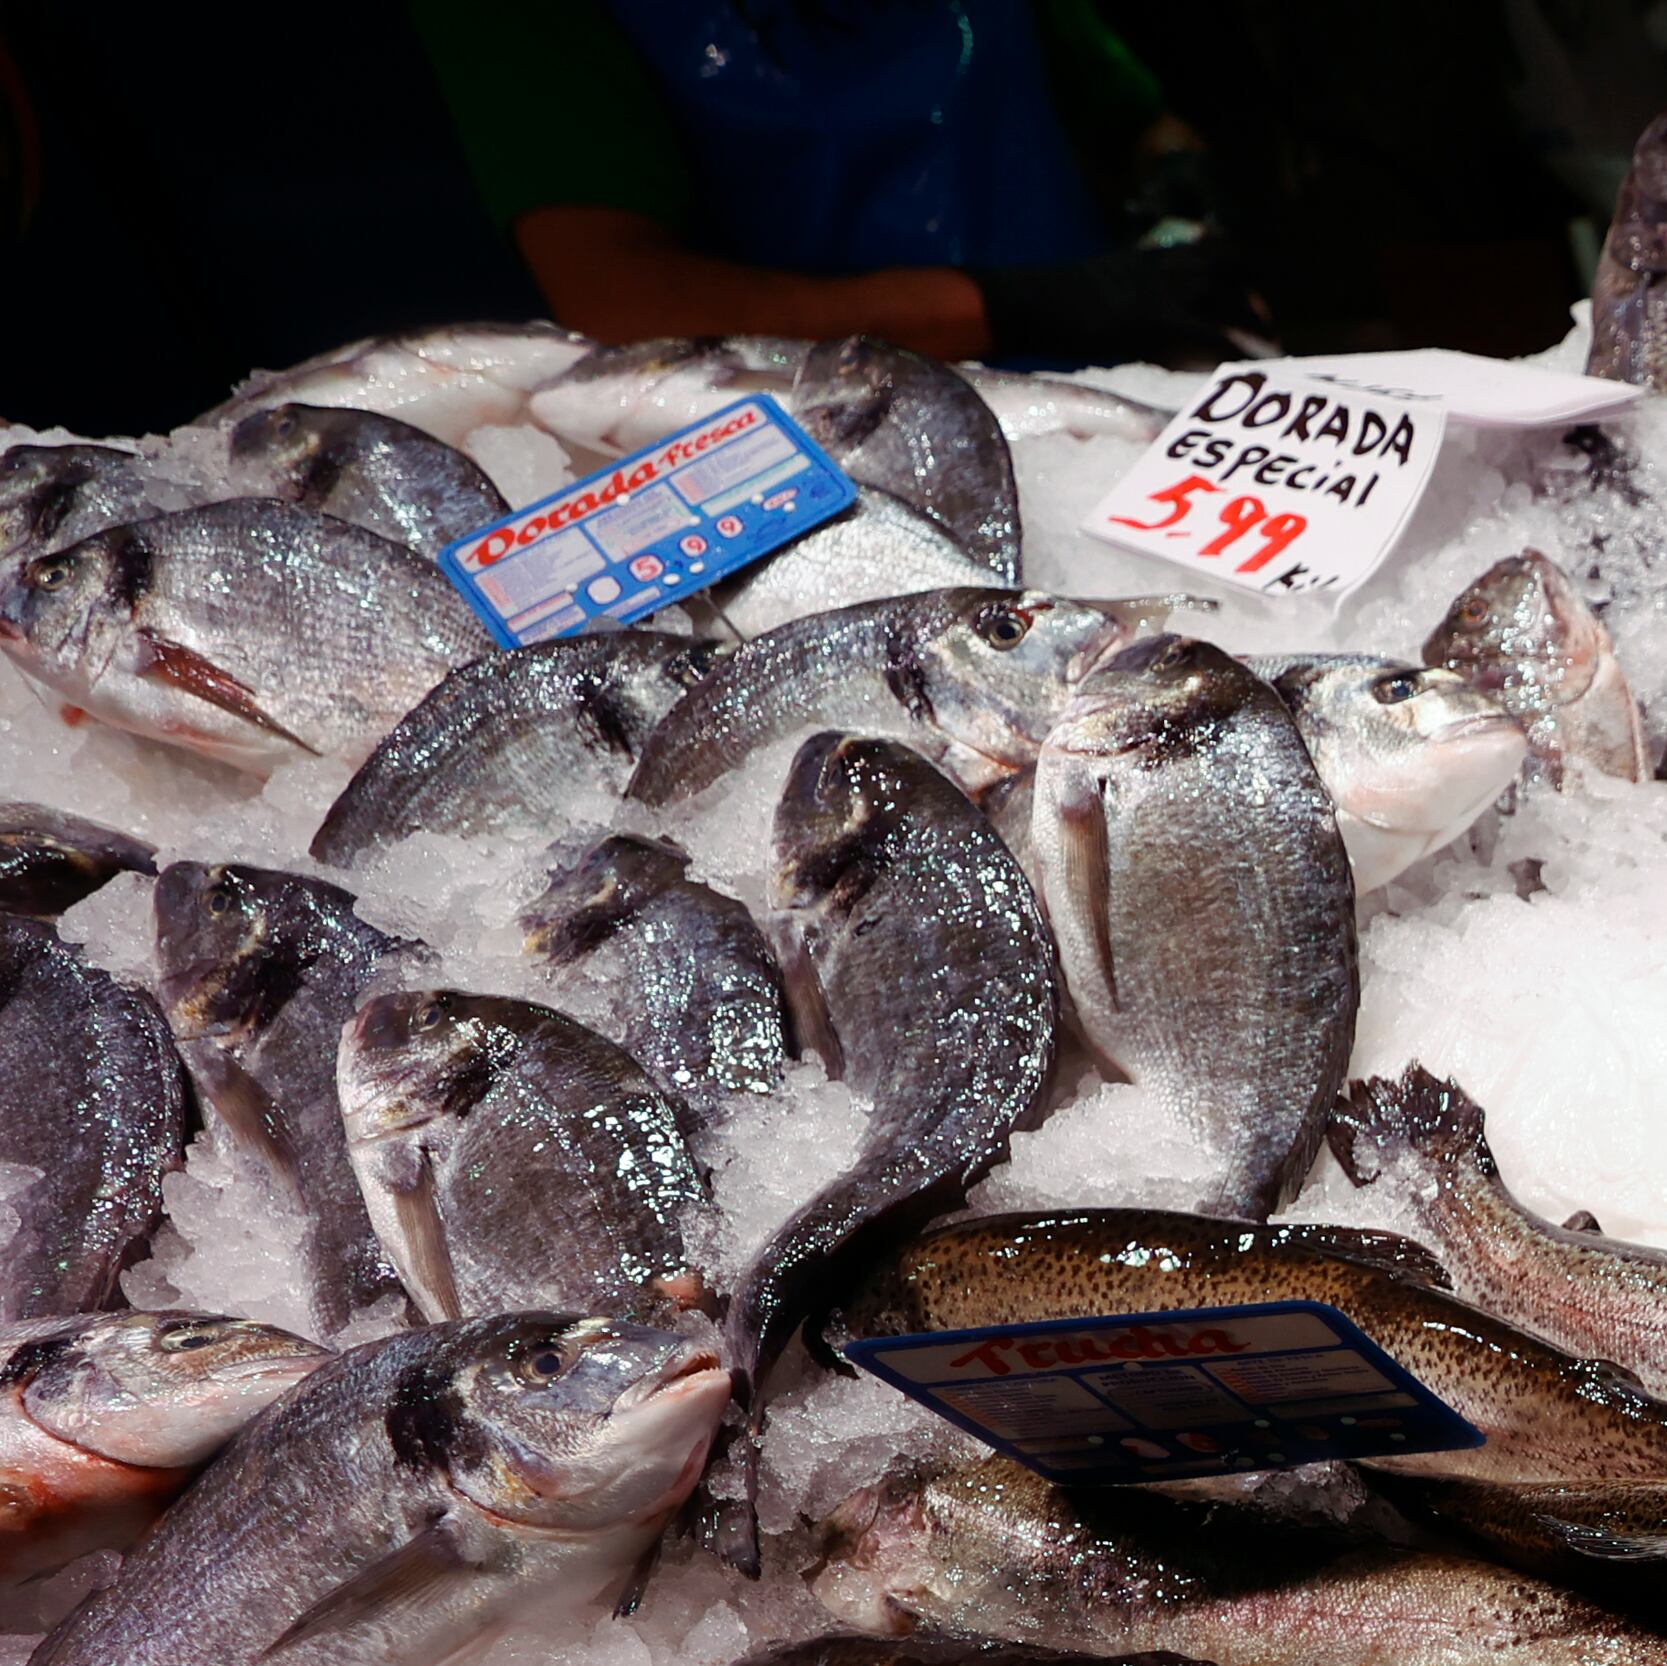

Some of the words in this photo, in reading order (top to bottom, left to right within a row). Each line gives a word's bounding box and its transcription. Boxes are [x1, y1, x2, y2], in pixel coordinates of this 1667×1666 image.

[1189, 372, 1415, 468] DORADA
[465, 459, 660, 566] Dorada
[950, 1326, 1252, 1376] Trucha
